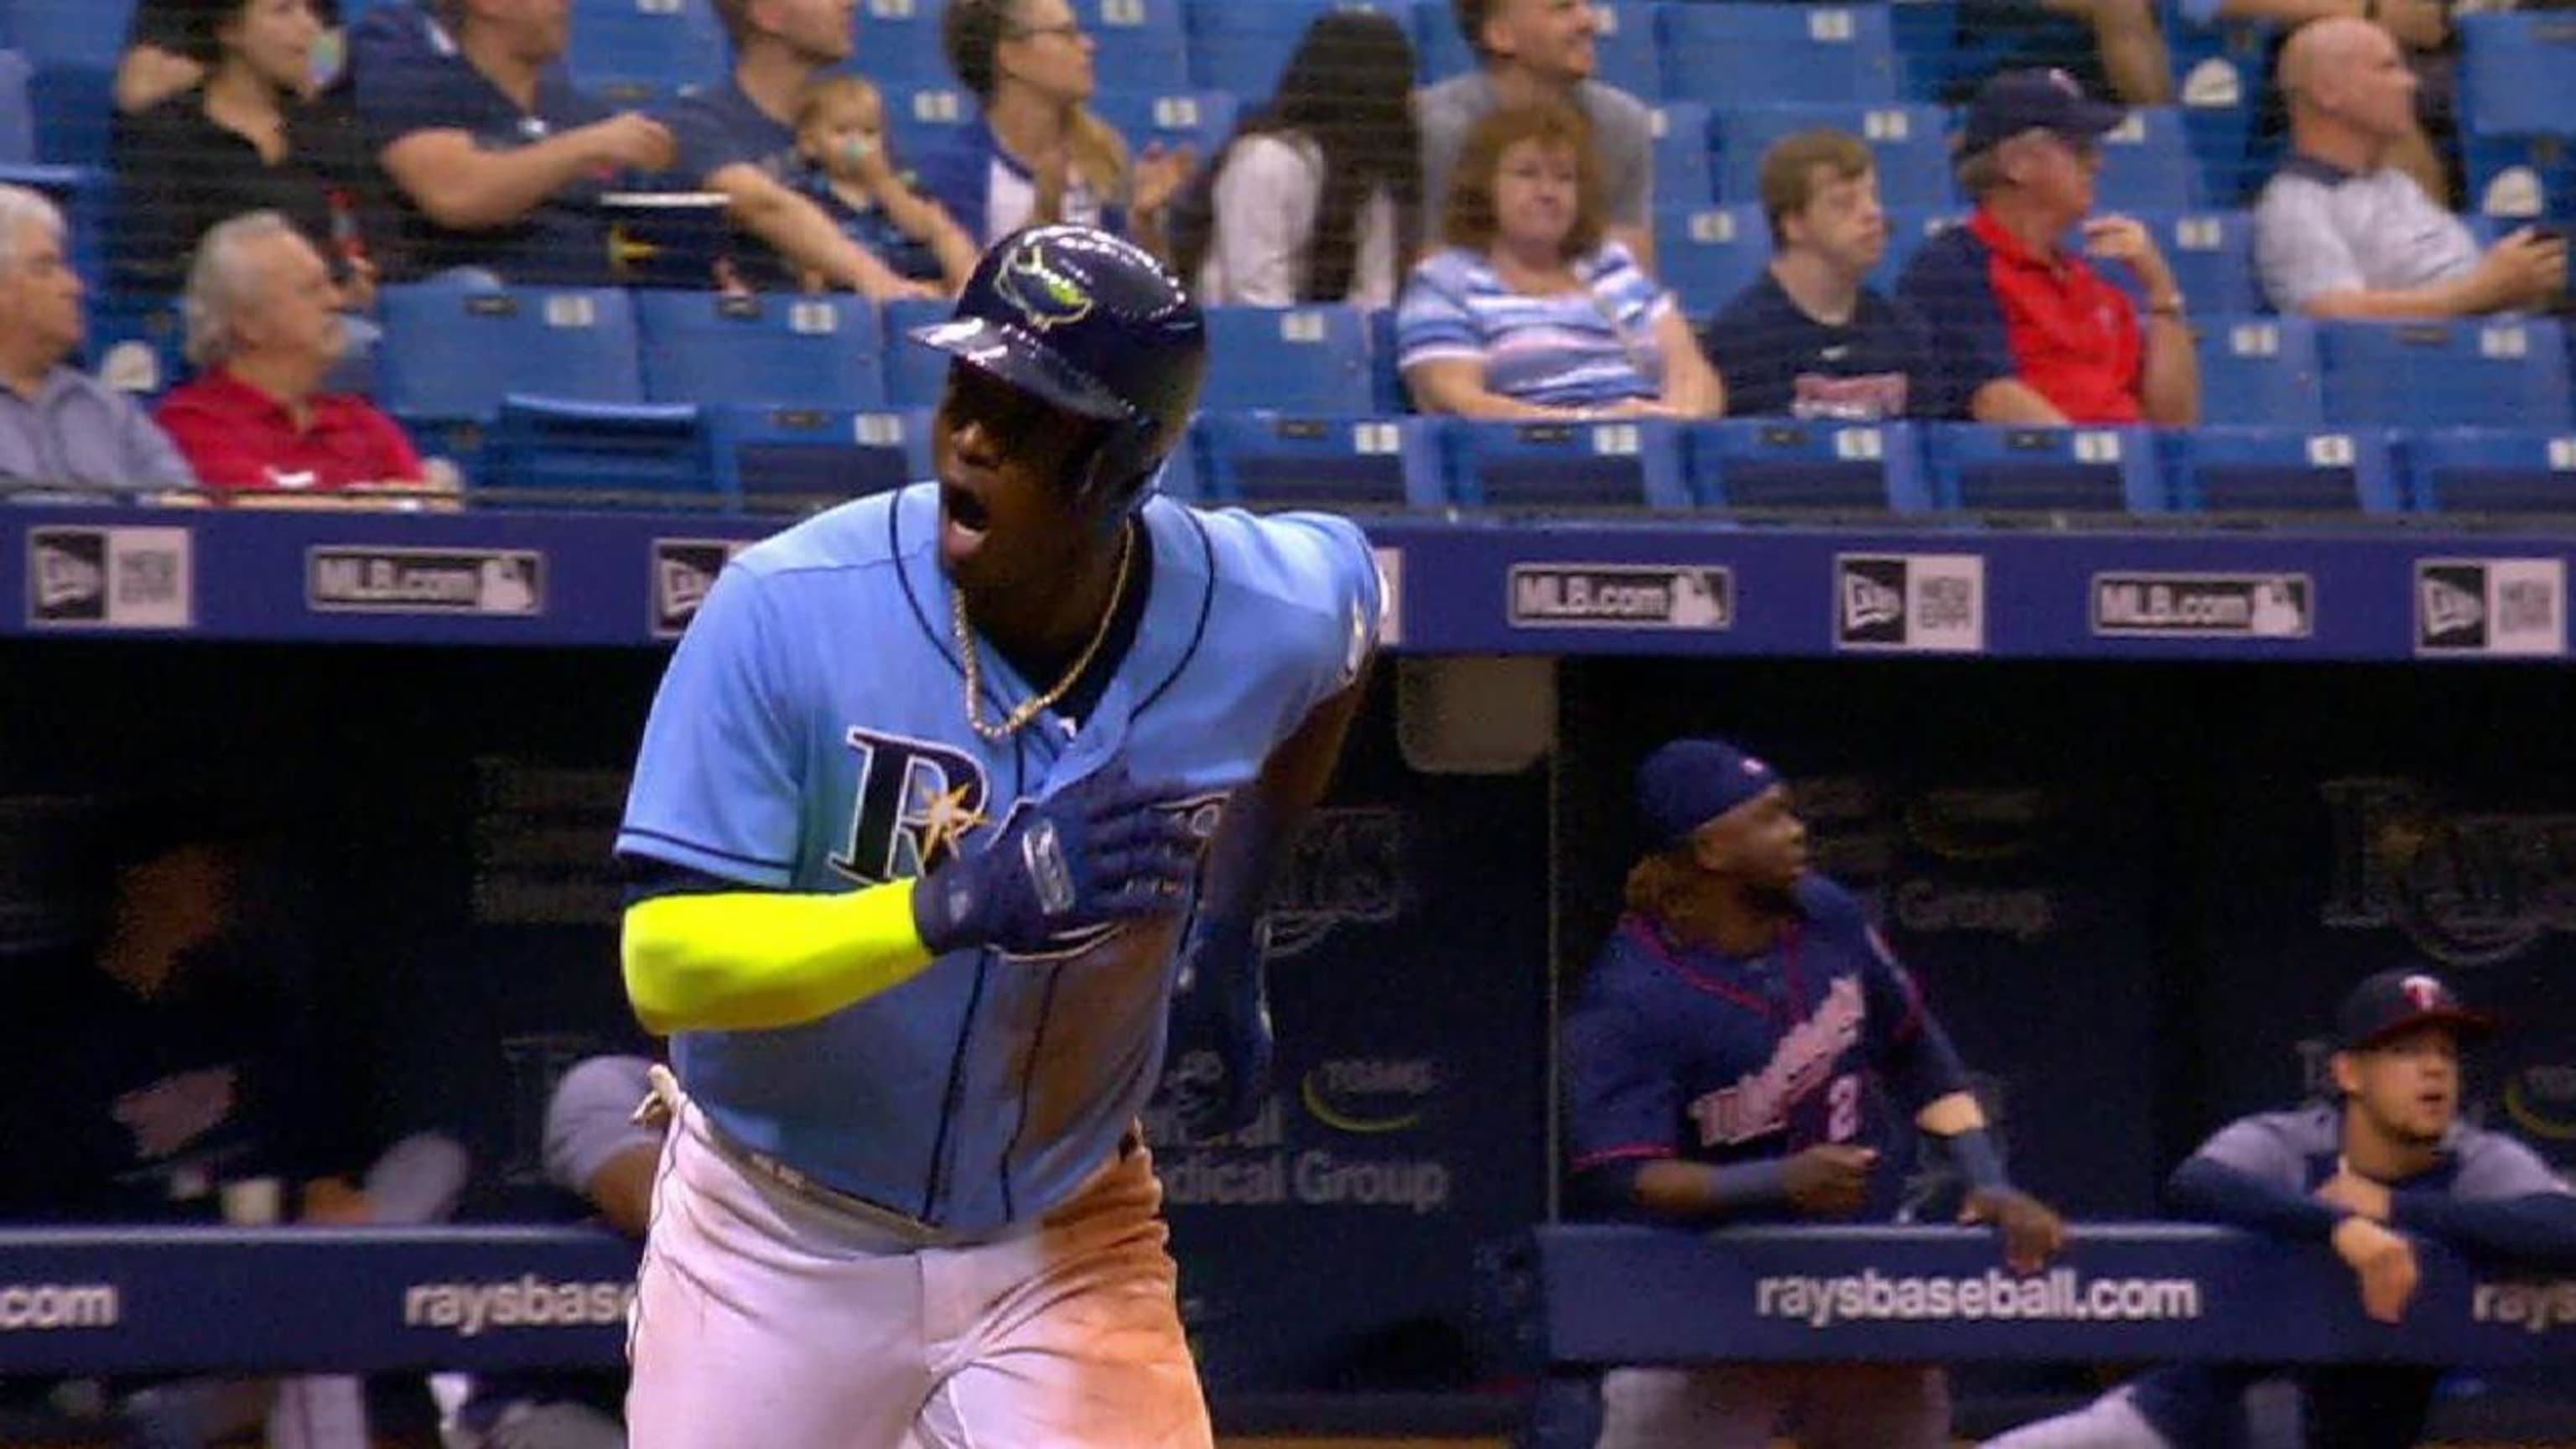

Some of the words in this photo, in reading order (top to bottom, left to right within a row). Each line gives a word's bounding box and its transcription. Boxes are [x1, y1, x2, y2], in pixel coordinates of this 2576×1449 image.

[319, 558, 478, 599] MLB.com
[1517, 575, 1668, 615] MLB.com
[2101, 584, 2249, 624] MLB.com
[1296, 1150, 1450, 1213] Group
[1757, 1267, 2199, 1329] raysbaseball.com
